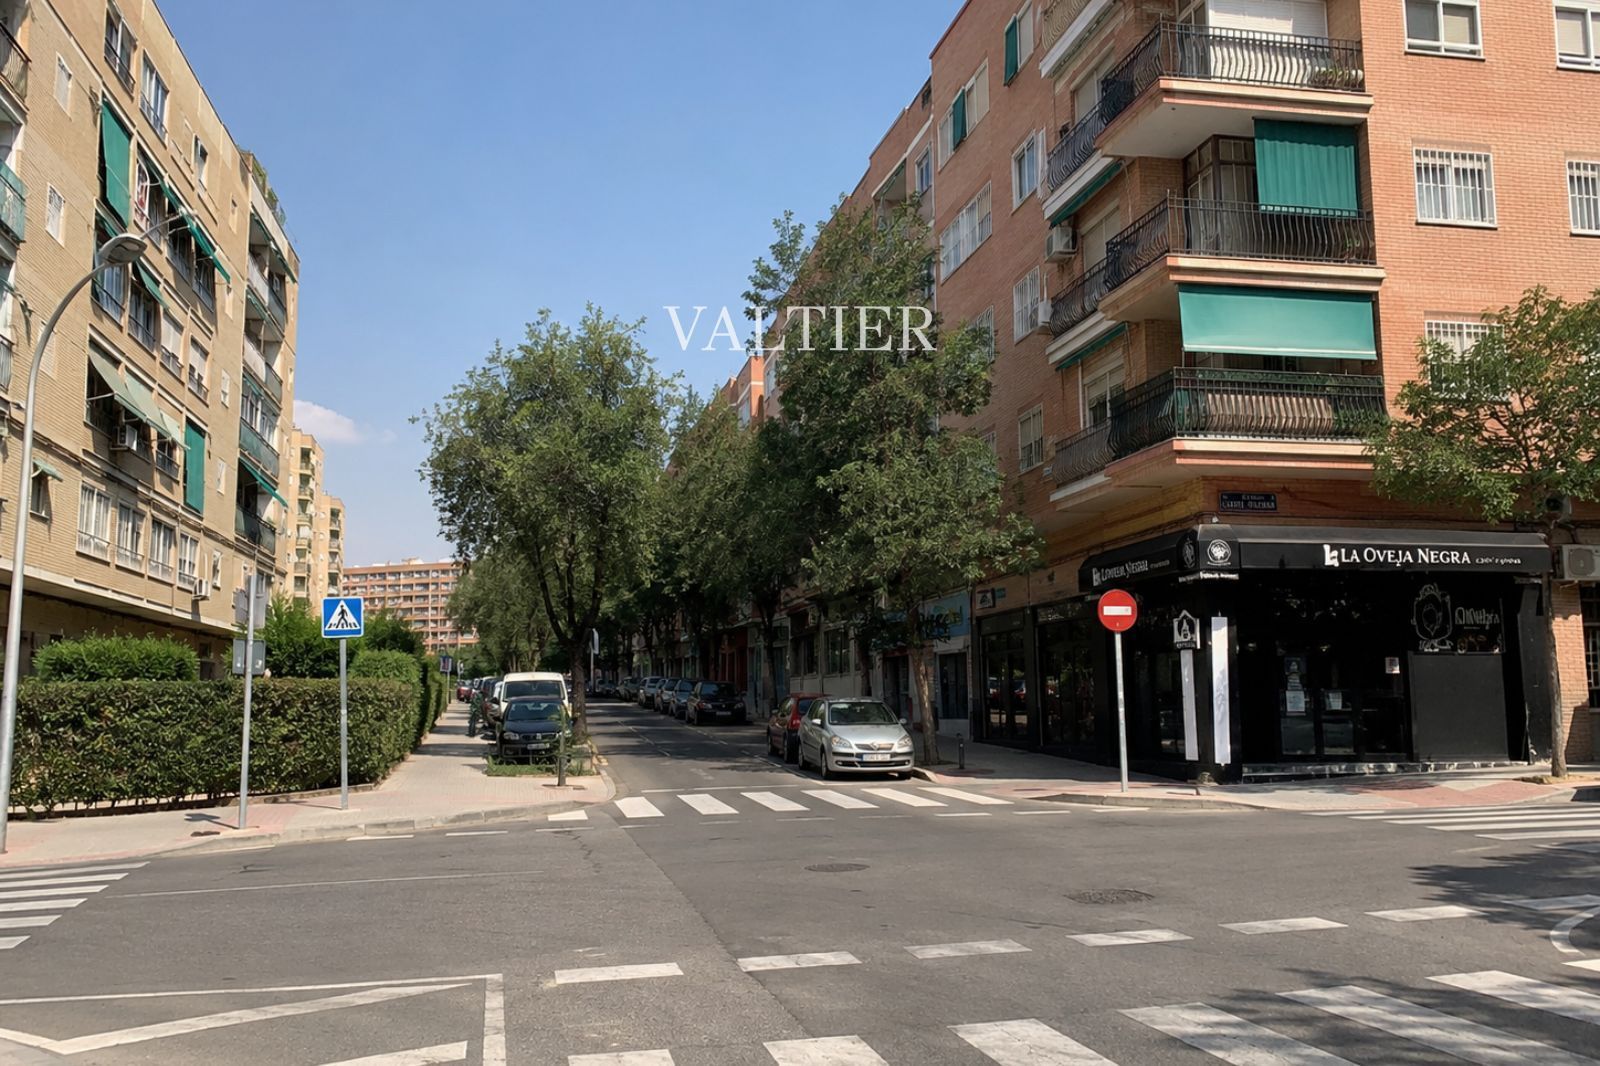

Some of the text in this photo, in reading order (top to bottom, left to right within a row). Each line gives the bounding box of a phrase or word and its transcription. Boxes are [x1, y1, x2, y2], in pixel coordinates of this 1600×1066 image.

[1341, 549, 1360, 563] LA
[1363, 547, 1414, 567] OVEJA
[1417, 548, 1471, 564] NEGRA
